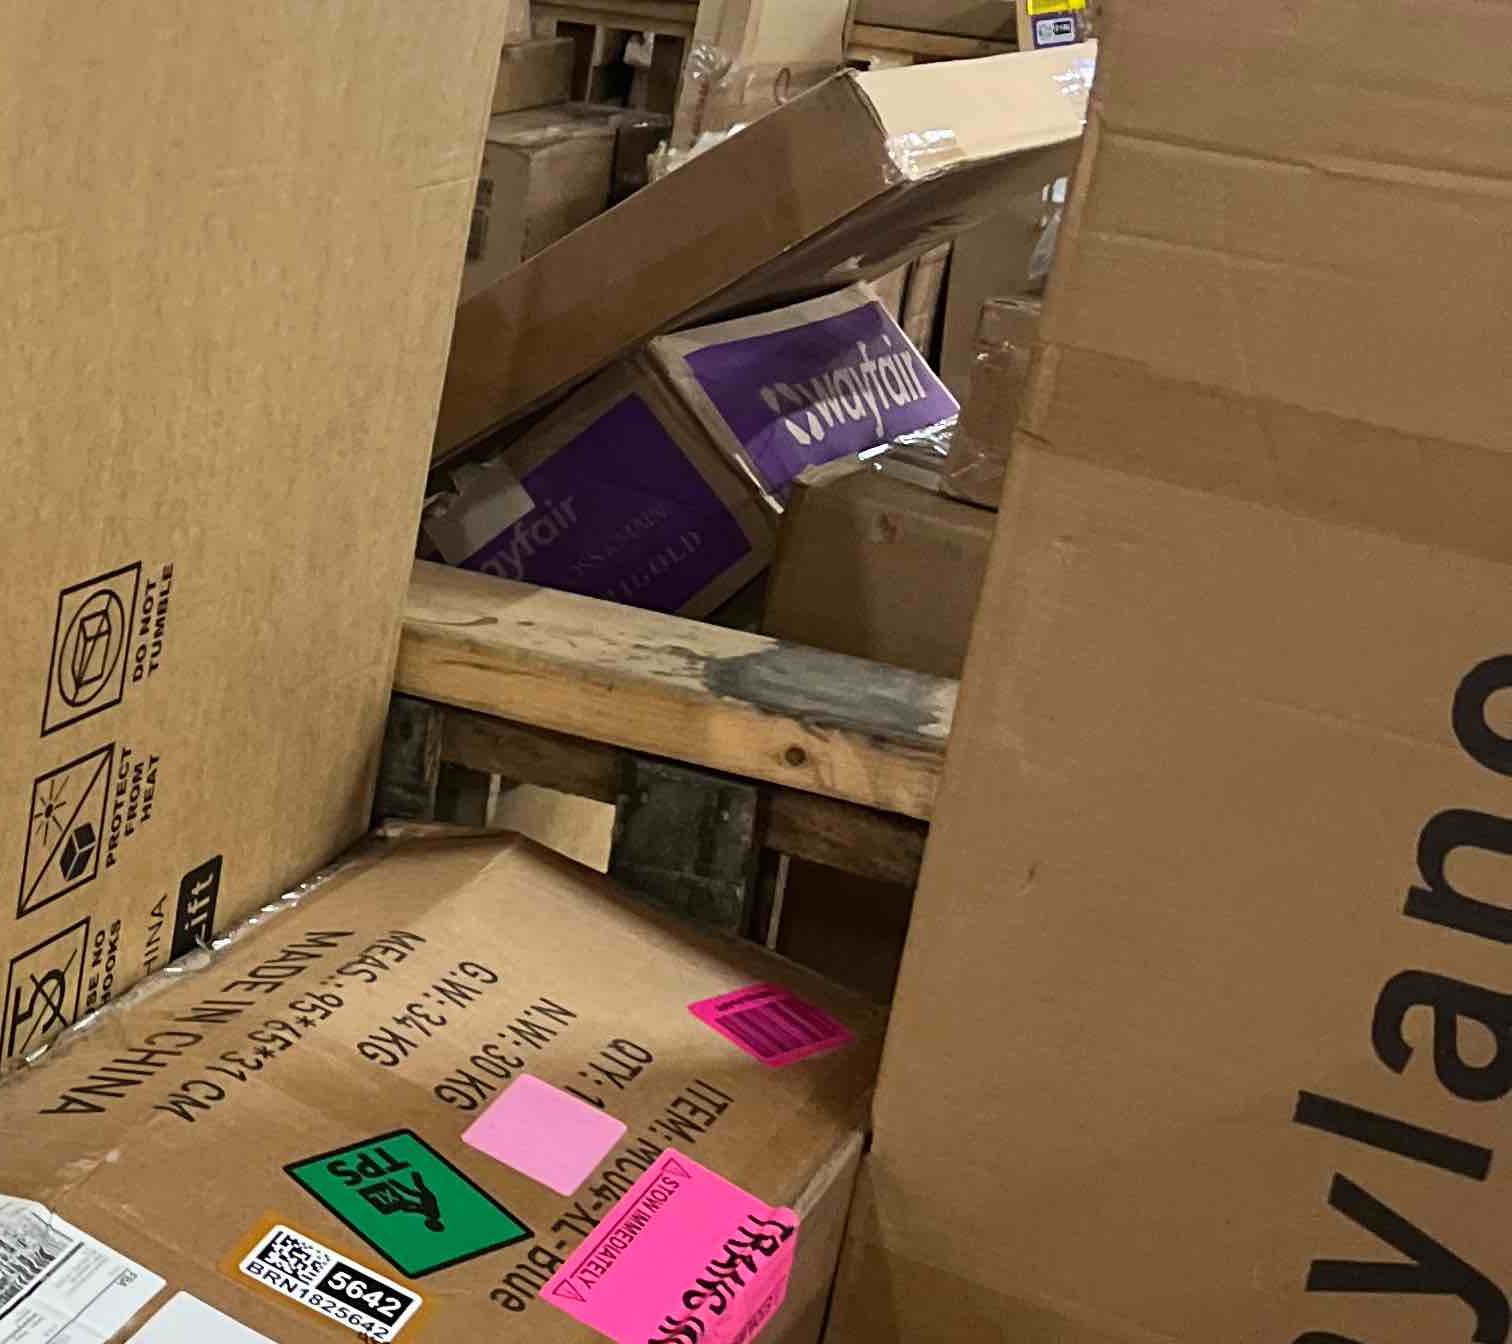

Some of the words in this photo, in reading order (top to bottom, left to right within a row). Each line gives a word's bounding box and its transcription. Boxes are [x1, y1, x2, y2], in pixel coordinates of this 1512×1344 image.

[812, 340, 928, 437] wayfair
[478, 496, 578, 580] ayfair
[132, 650, 146, 683] DO
[140, 577, 159, 643] NOT
[148, 562, 174, 678] TUMBLE
[105, 747, 133, 870] PROTECT
[124, 761, 145, 837] FROM
[140, 754, 160, 824] HEAT
[92, 930, 106, 962] NO
[141, 894, 170, 976] HINA
[222, 931, 354, 998] MADE
[175, 995, 253, 1030] IN
[39, 1028, 203, 1112] CHINA
[151, 1075, 226, 1123] CM
[581, 1034, 654, 1096] QTY:
[647, 1076, 733, 1150] ITEM:
[324, 1143, 409, 1191] TPS
[640, 1173, 681, 1215] STOW
[574, 1208, 651, 1290] IMMEDIATELY
[244, 1259, 391, 1342] BRN1825642
[325, 1269, 404, 1320] 5642
